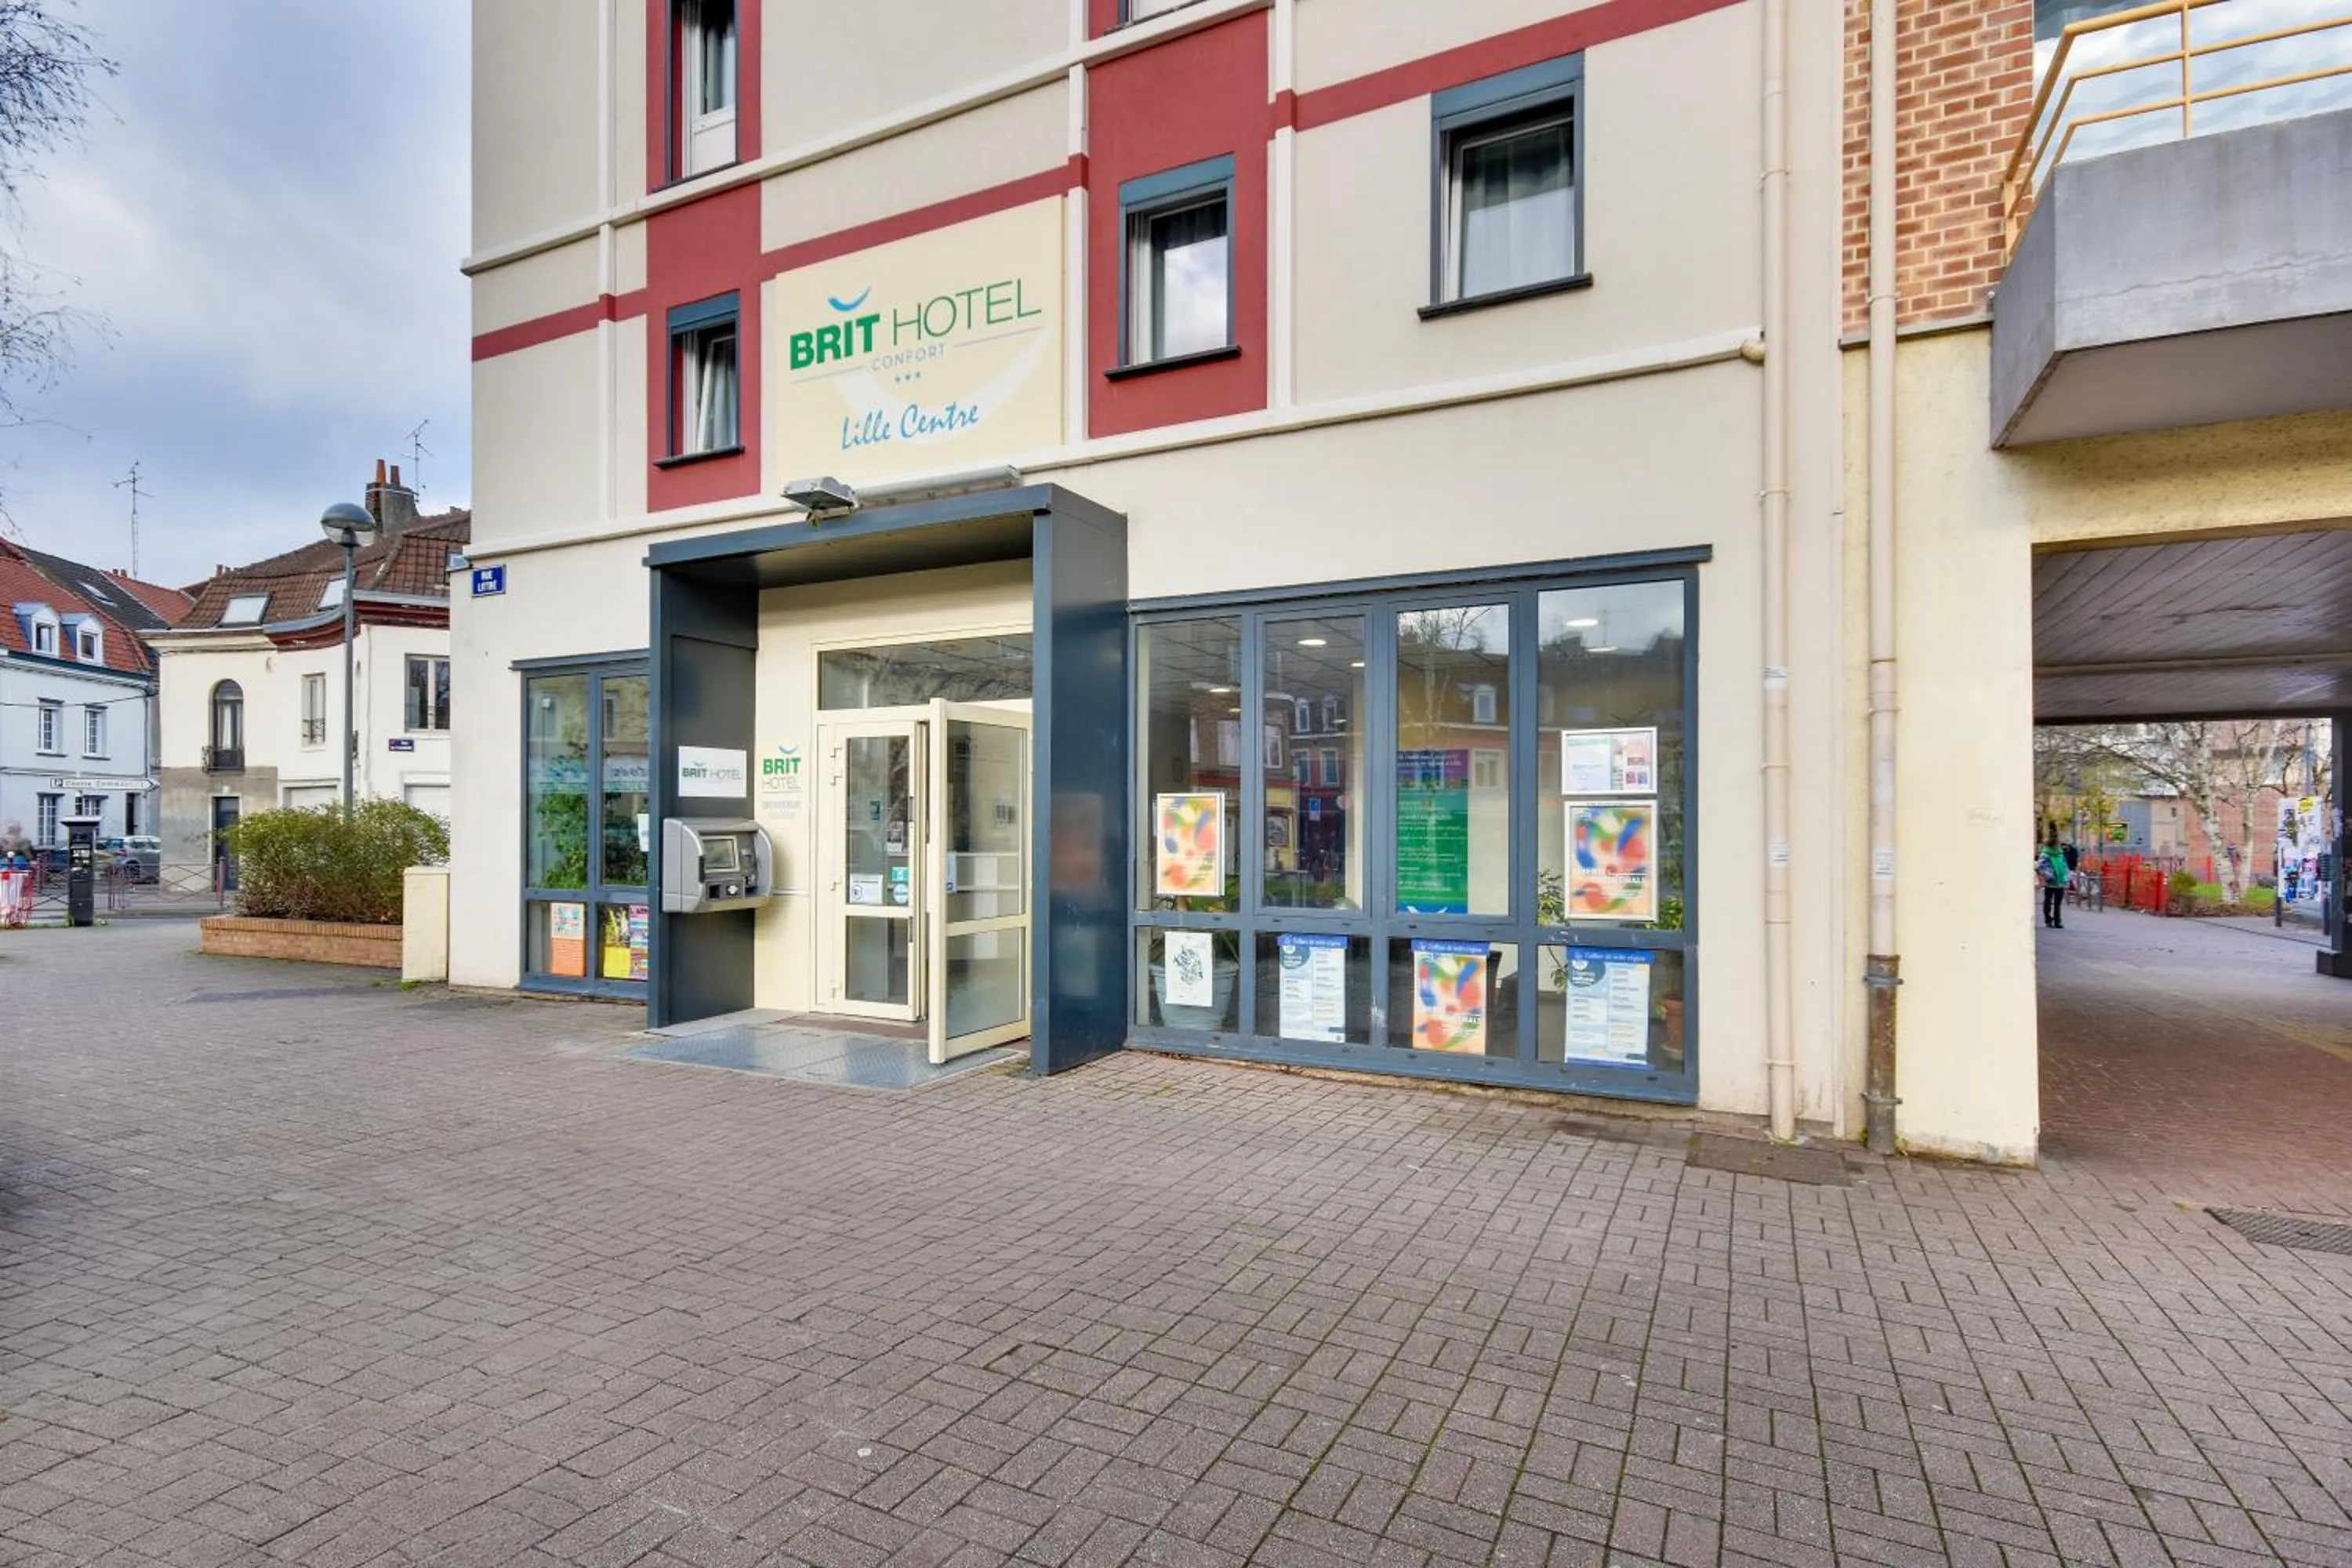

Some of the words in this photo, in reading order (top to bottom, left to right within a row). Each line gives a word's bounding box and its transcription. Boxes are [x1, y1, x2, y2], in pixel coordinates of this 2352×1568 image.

[789, 314, 880, 370] BRIT
[893, 278, 1042, 346] HOTEL
[871, 344, 946, 372] CONFORT
[841, 409, 891, 450] Lille
[899, 401, 978, 439] Centre
[681, 767, 707, 778] BRIT
[710, 768, 742, 780] HOTEL
[763, 757, 801, 775] BRIT
[762, 776, 801, 789] HOTEL
